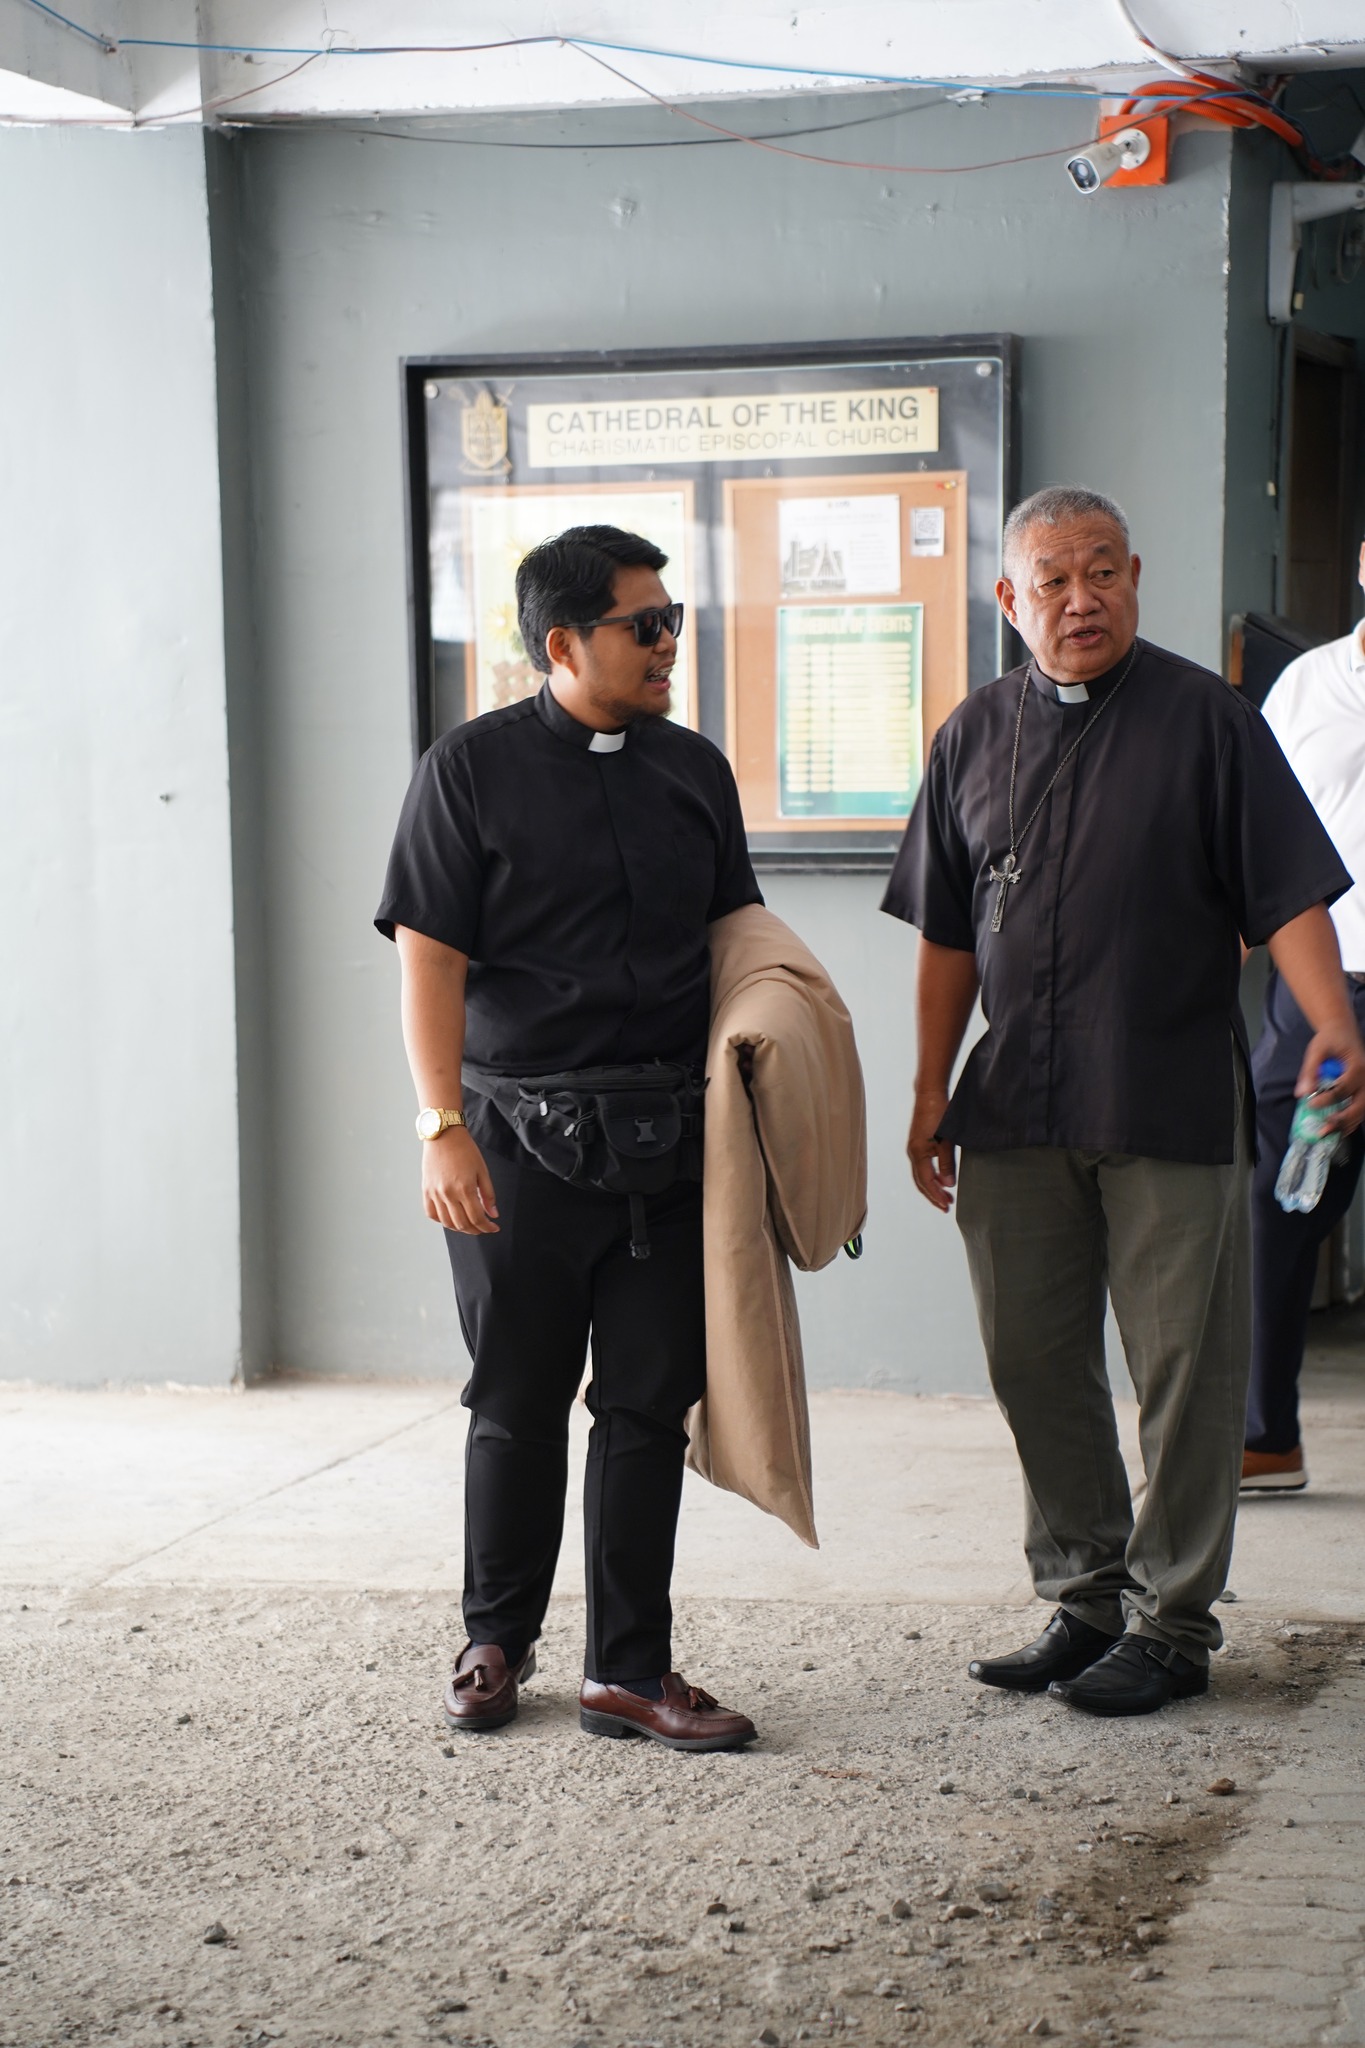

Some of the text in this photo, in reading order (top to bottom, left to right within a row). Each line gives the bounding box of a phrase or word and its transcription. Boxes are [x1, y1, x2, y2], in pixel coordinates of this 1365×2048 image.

[547, 396, 919, 434] CATHEDRAL OF THE KING
[547, 426, 918, 458] CHARISMATIC EPISCOPAL CHURCH
